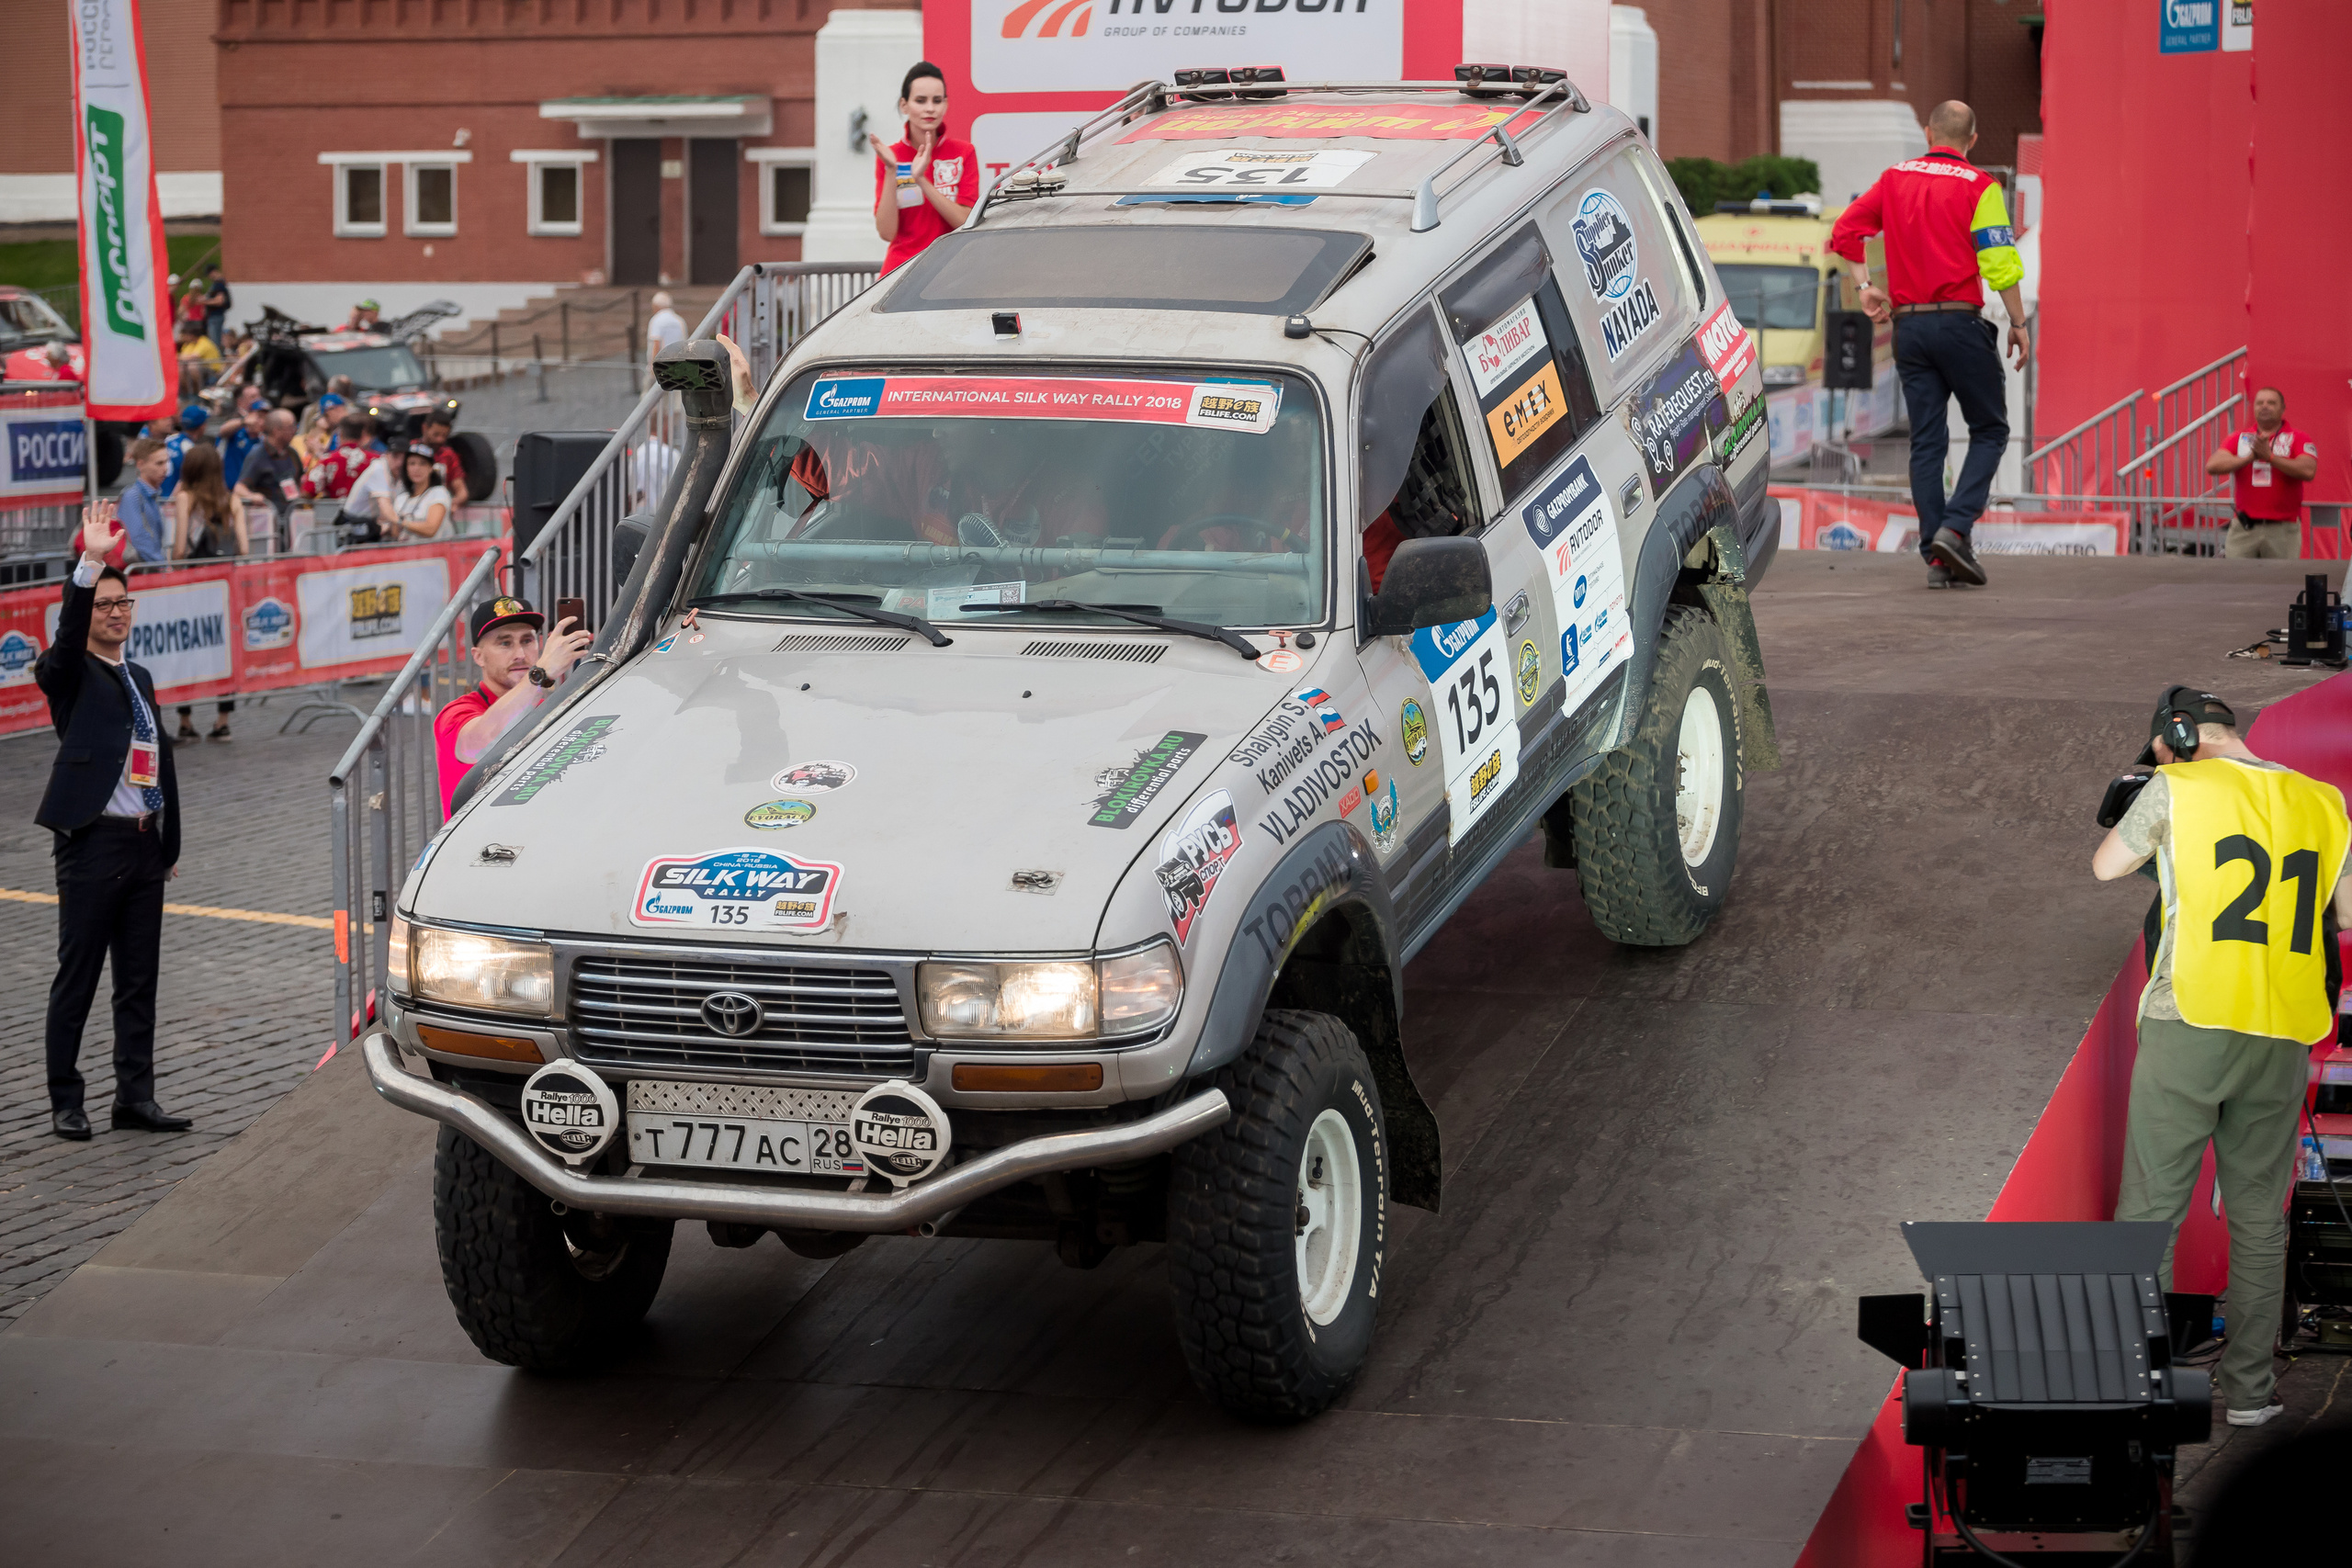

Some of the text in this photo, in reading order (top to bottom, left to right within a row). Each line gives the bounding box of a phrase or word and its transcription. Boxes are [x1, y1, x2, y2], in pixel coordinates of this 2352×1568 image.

[1103, 26, 1247, 37] GROUP OF COMPANIES
[1176, 166, 1311, 185] 135
[1600, 281, 1659, 358] NAYADA
[833, 396, 871, 407] GAZPROM
[887, 390, 1182, 409] INTERNATIONAL SILK WAY RALLY 2018
[1201, 396, 1261, 413] 越野e族
[1648, 369, 1714, 440] RATEREQUEST.ru
[1199, 409, 1257, 422] FBLIFE.COM
[1546, 472, 1589, 520] GAZPROMBANK
[1569, 508, 1604, 554] AVTODOR
[1447, 618, 1480, 652] GAZPROM
[1267, 654, 1293, 670] E
[1448, 647, 1500, 755] 135
[1702, 658, 1741, 740] Mud-Terrain
[1228, 702, 1309, 768] Shalygin S.
[509, 729, 583, 792] differential parts
[514, 718, 614, 800] BLOKIROVKA.RU
[1256, 721, 1328, 795] Kanivets A.
[1094, 735, 1184, 822] BLOKIROVKA.RU
[1125, 747, 1192, 814] differential parts
[1258, 717, 1383, 845] VLADIVOSTOK
[1176, 818, 1233, 870] РУСЬ
[660, 868, 821, 889] SILK WAY
[1198, 857, 1226, 883] СПОРТ
[703, 887, 767, 897] RALLY
[2211, 833, 2320, 956] 21
[658, 905, 693, 915] GAZPROM
[710, 905, 750, 925] 135
[540, 1091, 598, 1104] Rallye 1000
[532, 1101, 599, 1126] Hella
[872, 1112, 932, 1127] Rallye 1000
[560, 1133, 593, 1143] HELLA
[813, 1128, 853, 1158] 28
[860, 1122, 933, 1150] Hella
[813, 1158, 842, 1171] RUS
[890, 1156, 923, 1168] HELLA
[1351, 1079, 1385, 1299] Mud-Terrain T/A
